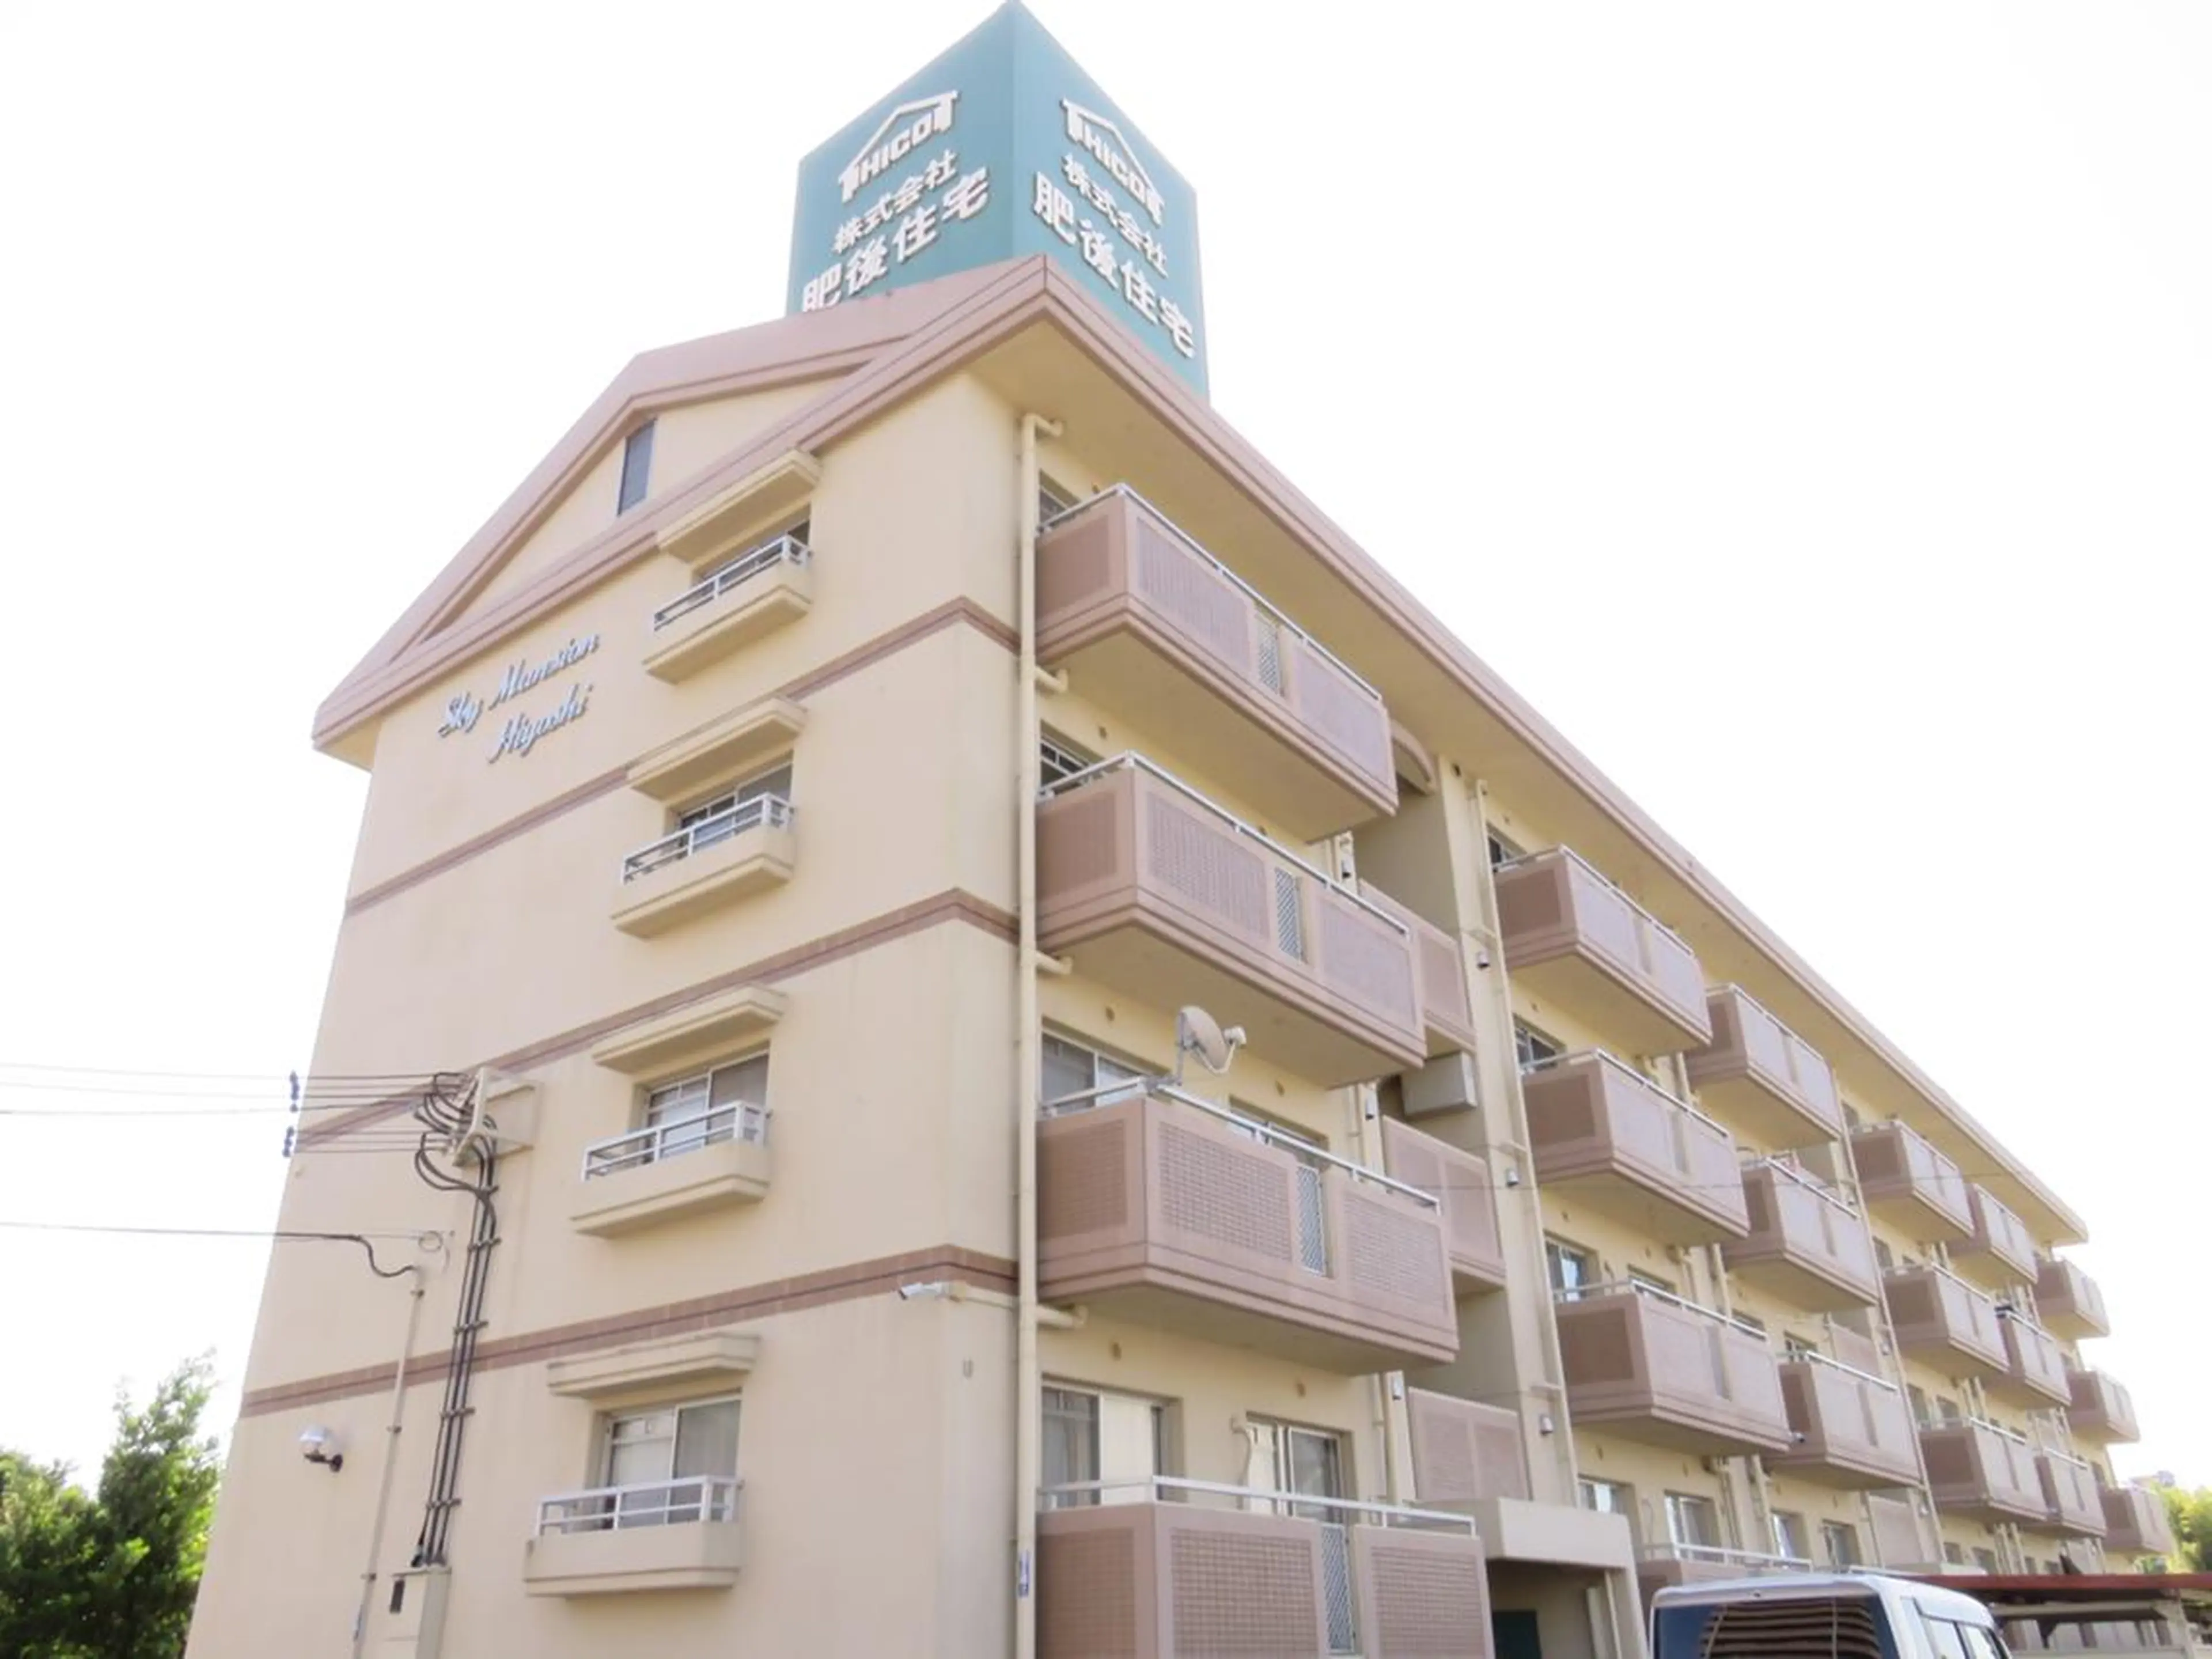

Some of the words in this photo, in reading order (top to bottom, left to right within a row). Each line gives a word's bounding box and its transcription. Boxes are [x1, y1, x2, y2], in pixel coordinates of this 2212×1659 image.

[803, 166, 989, 312] 肥後住宅
[834, 149, 957, 254] 株式会社
[1034, 171, 1196, 359] 肥後住宅
[1061, 152, 1168, 279] 株式会社
[438, 691, 483, 737] Sky
[488, 634, 599, 710] Mansion
